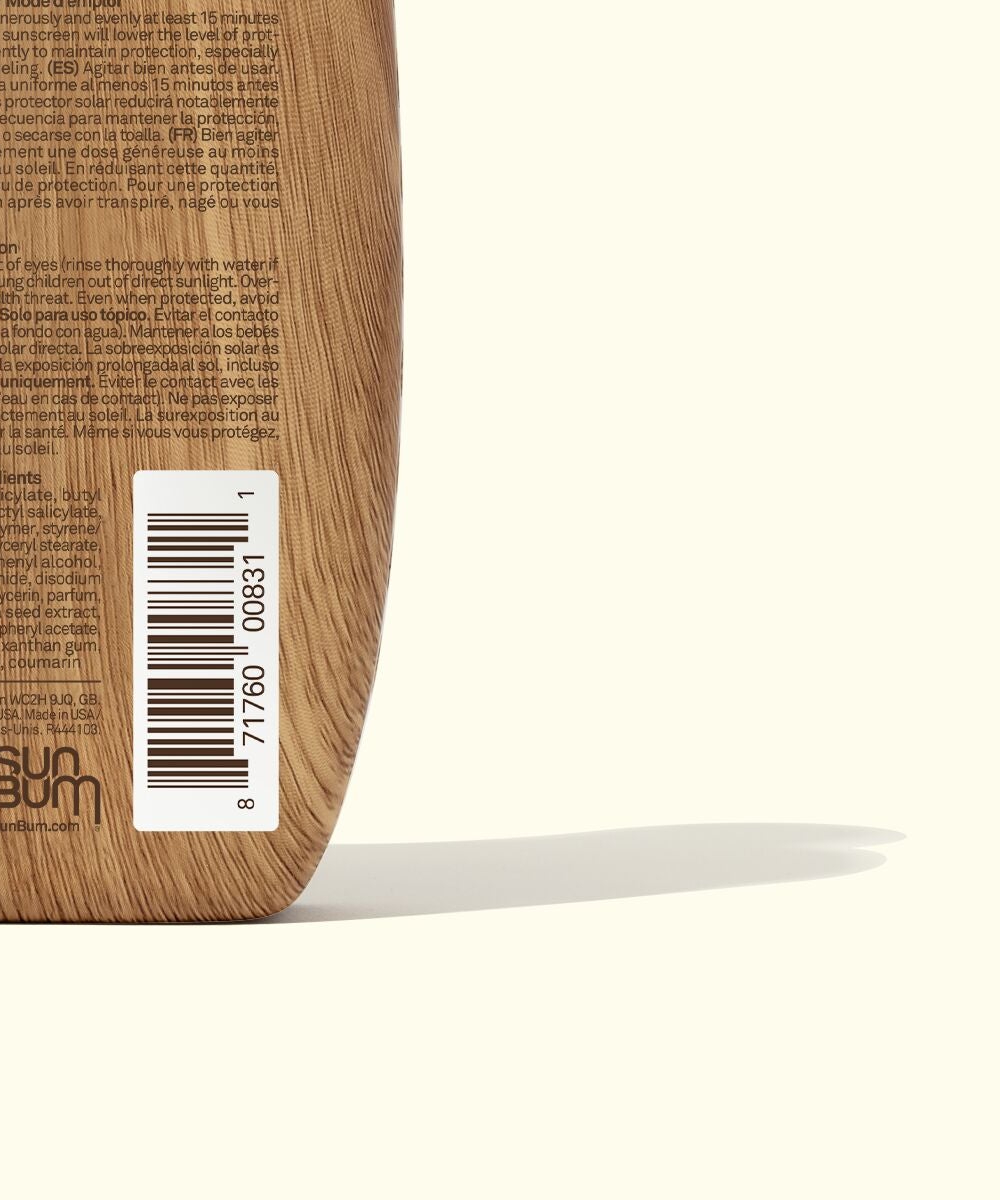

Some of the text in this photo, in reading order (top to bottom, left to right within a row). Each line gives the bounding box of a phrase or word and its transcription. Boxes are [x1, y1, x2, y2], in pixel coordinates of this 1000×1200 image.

[64, 11, 91, 24] and
[94, 11, 141, 28] evenly
[144, 11, 159, 24] at
[161, 11, 197, 24] least
[200, 11, 217, 24] 15
[220, 11, 279, 24] minutes
[15, 441, 59, 455] soleil.
[41, 554, 102, 570] alcohol,
[237, 491, 265, 810] 8 71760 00831 1
[8, 655, 81, 668] coumarin
